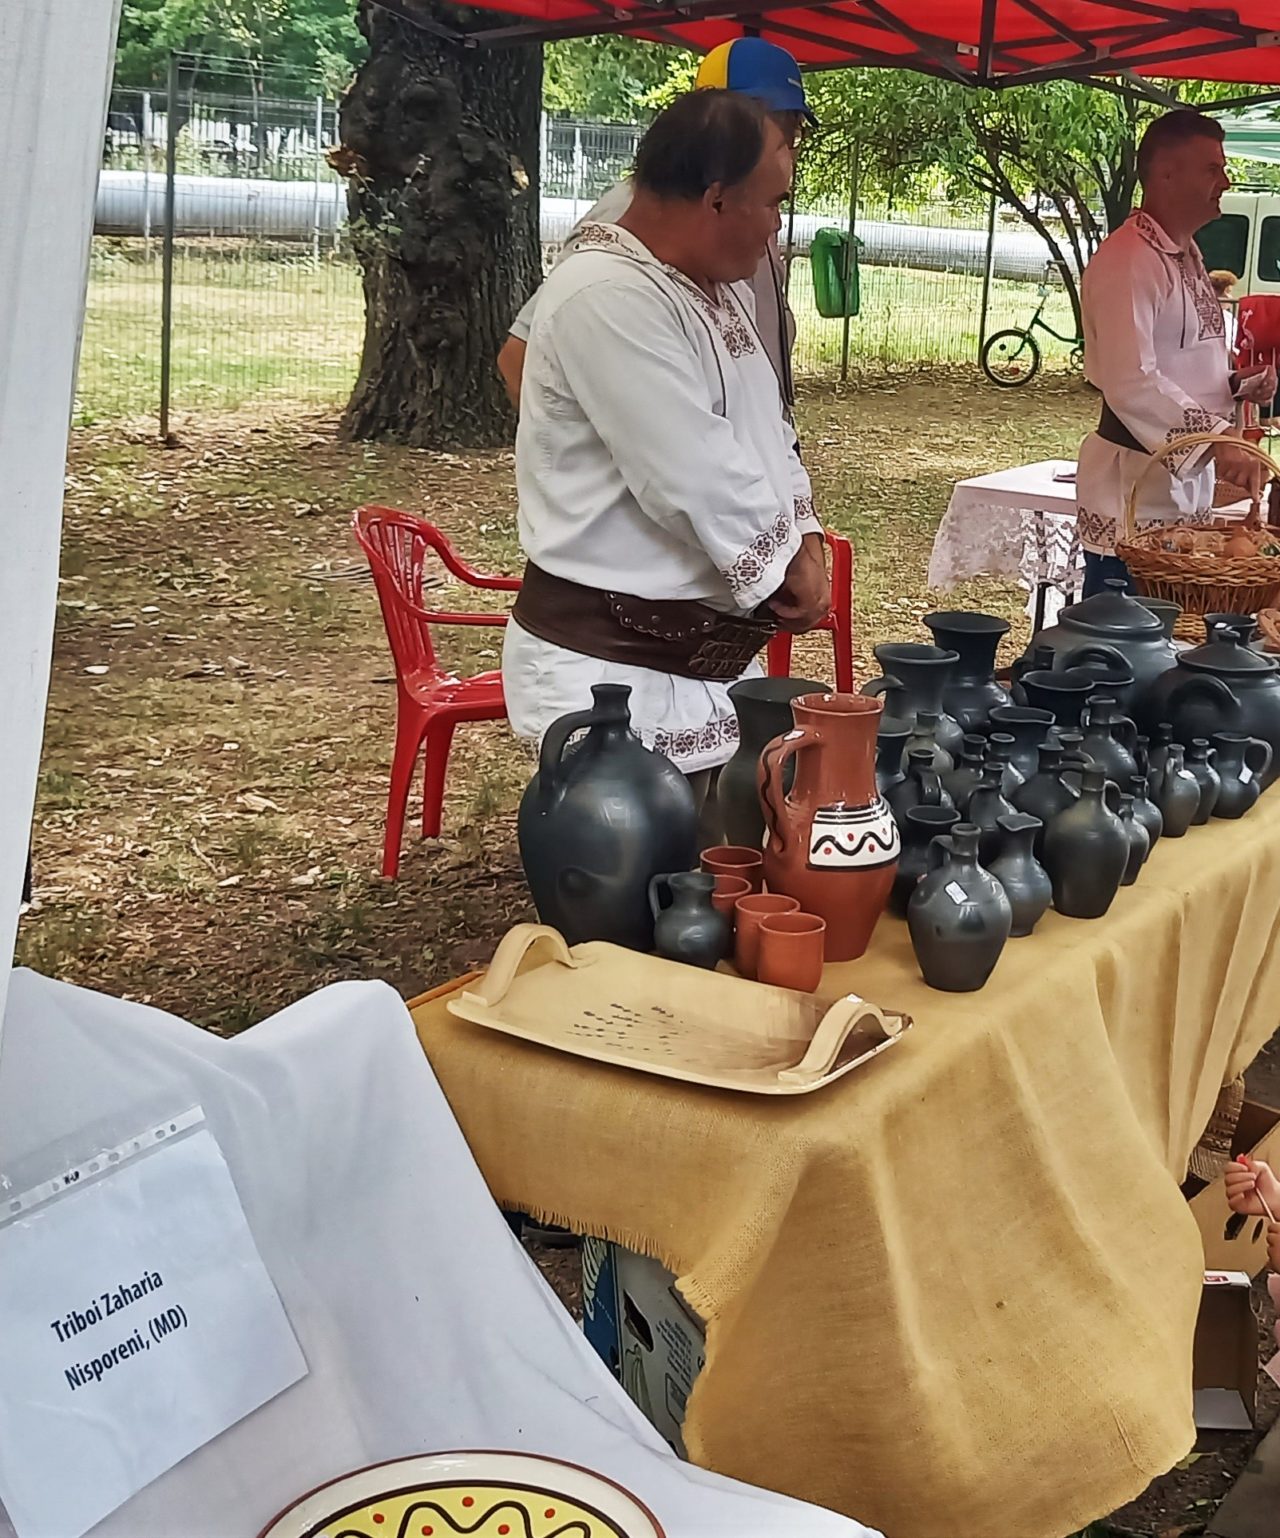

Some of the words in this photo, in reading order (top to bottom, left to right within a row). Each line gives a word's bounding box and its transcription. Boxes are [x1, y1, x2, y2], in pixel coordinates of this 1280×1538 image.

[50, 1299, 103, 1343] Triboi
[100, 1271, 164, 1317] Zaharia
[64, 1328, 150, 1391] Nisporeni,
[148, 1304, 188, 1344] (MD)
